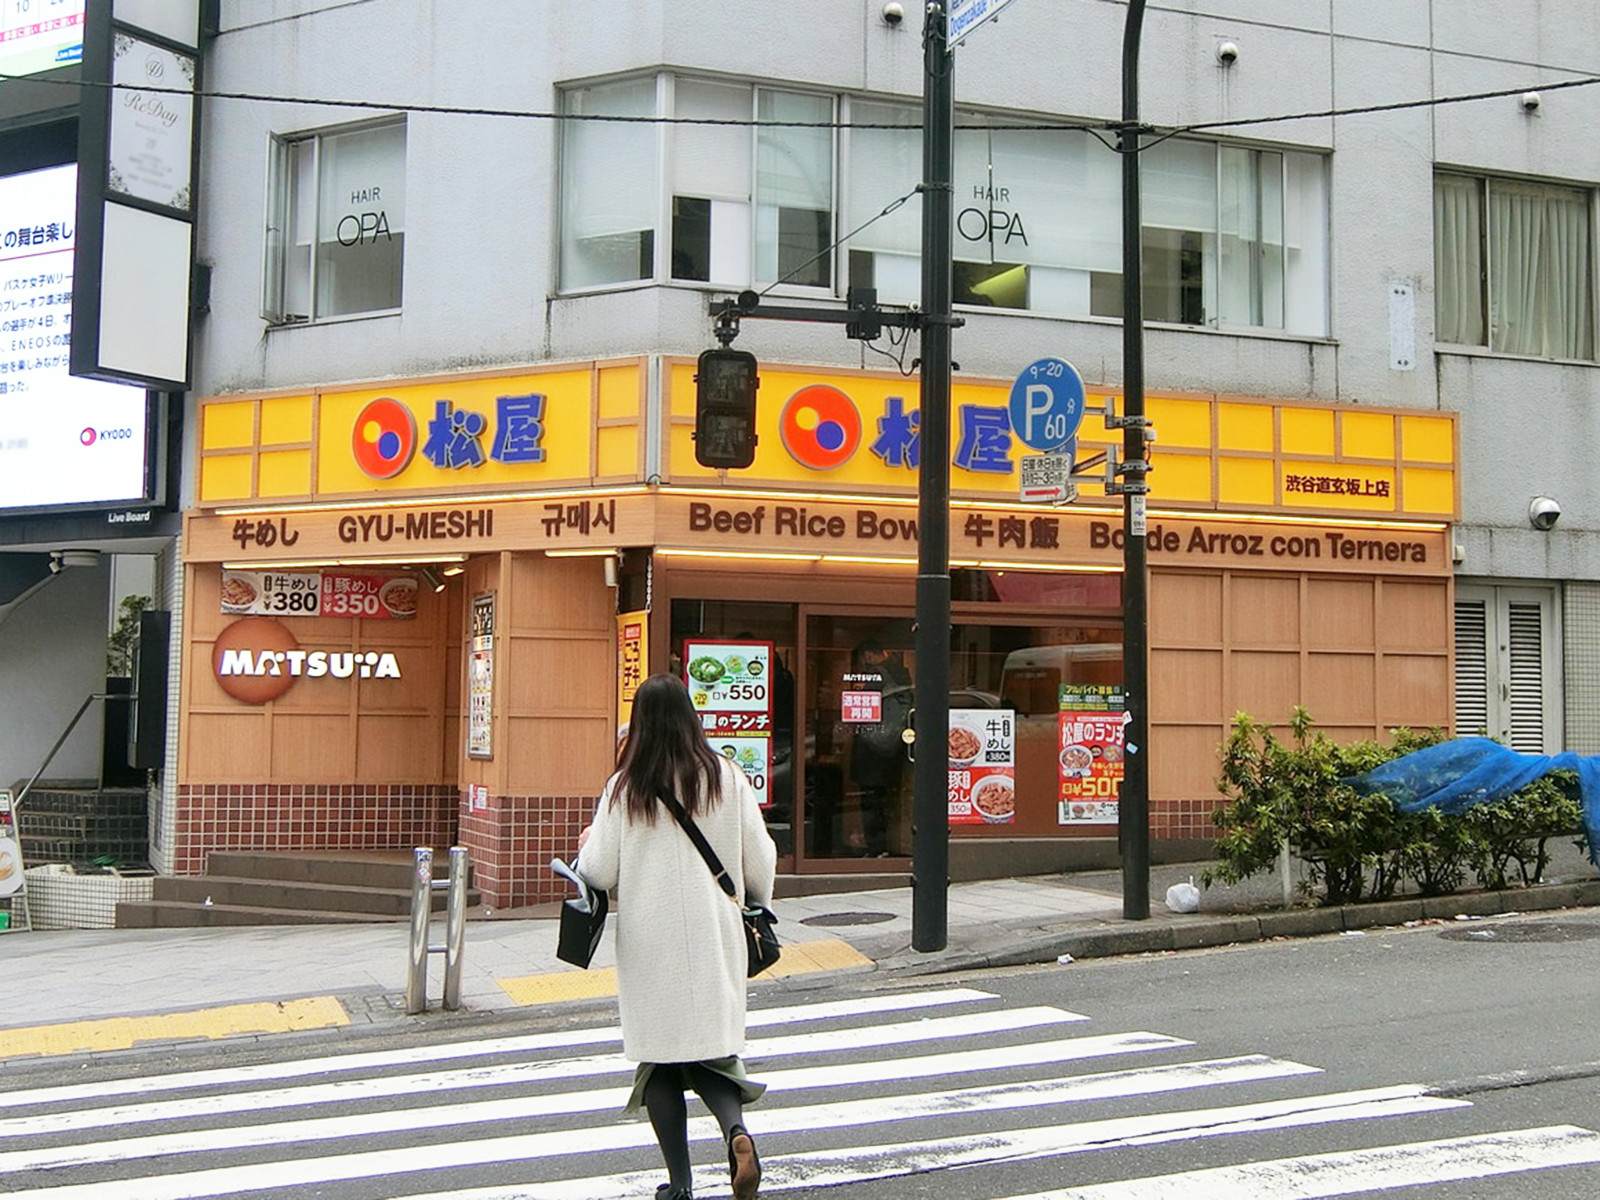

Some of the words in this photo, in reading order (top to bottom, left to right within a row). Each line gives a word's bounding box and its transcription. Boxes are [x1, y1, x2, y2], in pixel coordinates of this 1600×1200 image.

[351, 187, 381, 204] HAIR
[973, 185, 1010, 202] HAIR
[0, 222, 73, 248] の舞台楽し
[337, 210, 392, 247] OPA
[957, 207, 1028, 246] OPA
[1030, 361, 1064, 379] 9-20
[1025, 384, 1054, 441] P
[100, 428, 132, 440] KYODO
[422, 393, 547, 469] 松屋
[1045, 414, 1066, 440] 60
[1286, 474, 1390, 498] 渋谷道玄坂上店
[108, 513, 125, 523] Live
[125, 511, 150, 522] Board
[338, 509, 493, 543] GYU-MESHI
[541, 499, 616, 538] 규메시
[689, 503, 765, 535] Beef
[774, 506, 846, 538] Rice
[855, 510, 919, 541] Bow
[232, 518, 299, 549] 牛めし
[964, 513, 1060, 549] 牛肉飯
[1090, 522, 1125, 550] Bo
[1146, 524, 1180, 552] de
[1186, 526, 1263, 556] Arroz
[1269, 536, 1321, 559] con
[1325, 532, 1427, 562] Ternera
[274, 575, 318, 591] 牛めし
[333, 577, 378, 594] 豚めし
[220, 650, 402, 679] MATSUYA
[697, 713, 770, 730] 屋のランチ
[986, 719, 1002, 736] 牛
[987, 738, 1011, 750] めし
